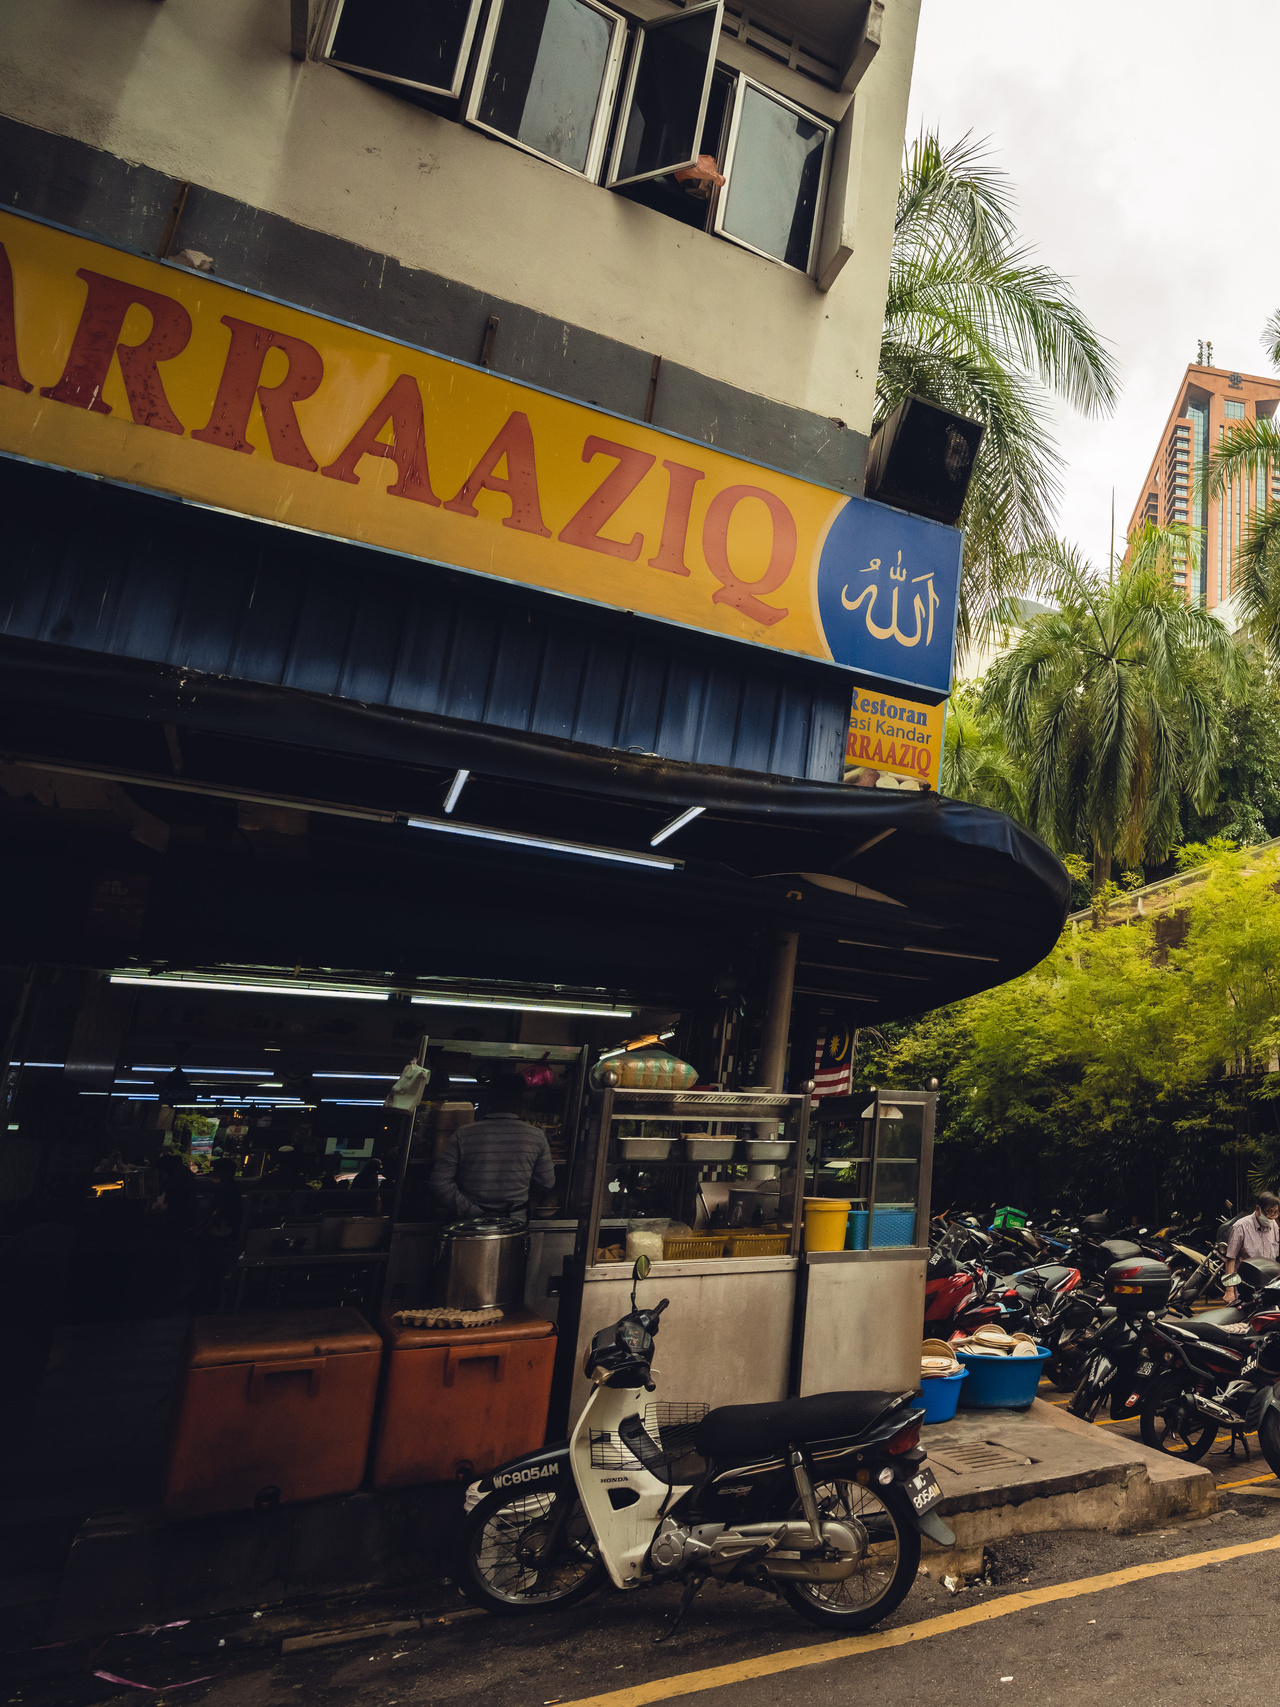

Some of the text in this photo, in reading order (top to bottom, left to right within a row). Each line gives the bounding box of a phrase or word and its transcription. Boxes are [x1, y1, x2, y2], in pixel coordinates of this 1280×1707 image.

[852, 689, 928, 727] Restoran
[876, 719, 932, 745] Kandar
[493, 1462, 559, 1489] WC8054M
[600, 1476, 629, 1484] HONDA
[912, 1474, 927, 1490] WC
[913, 1482, 941, 1509] 8054M
